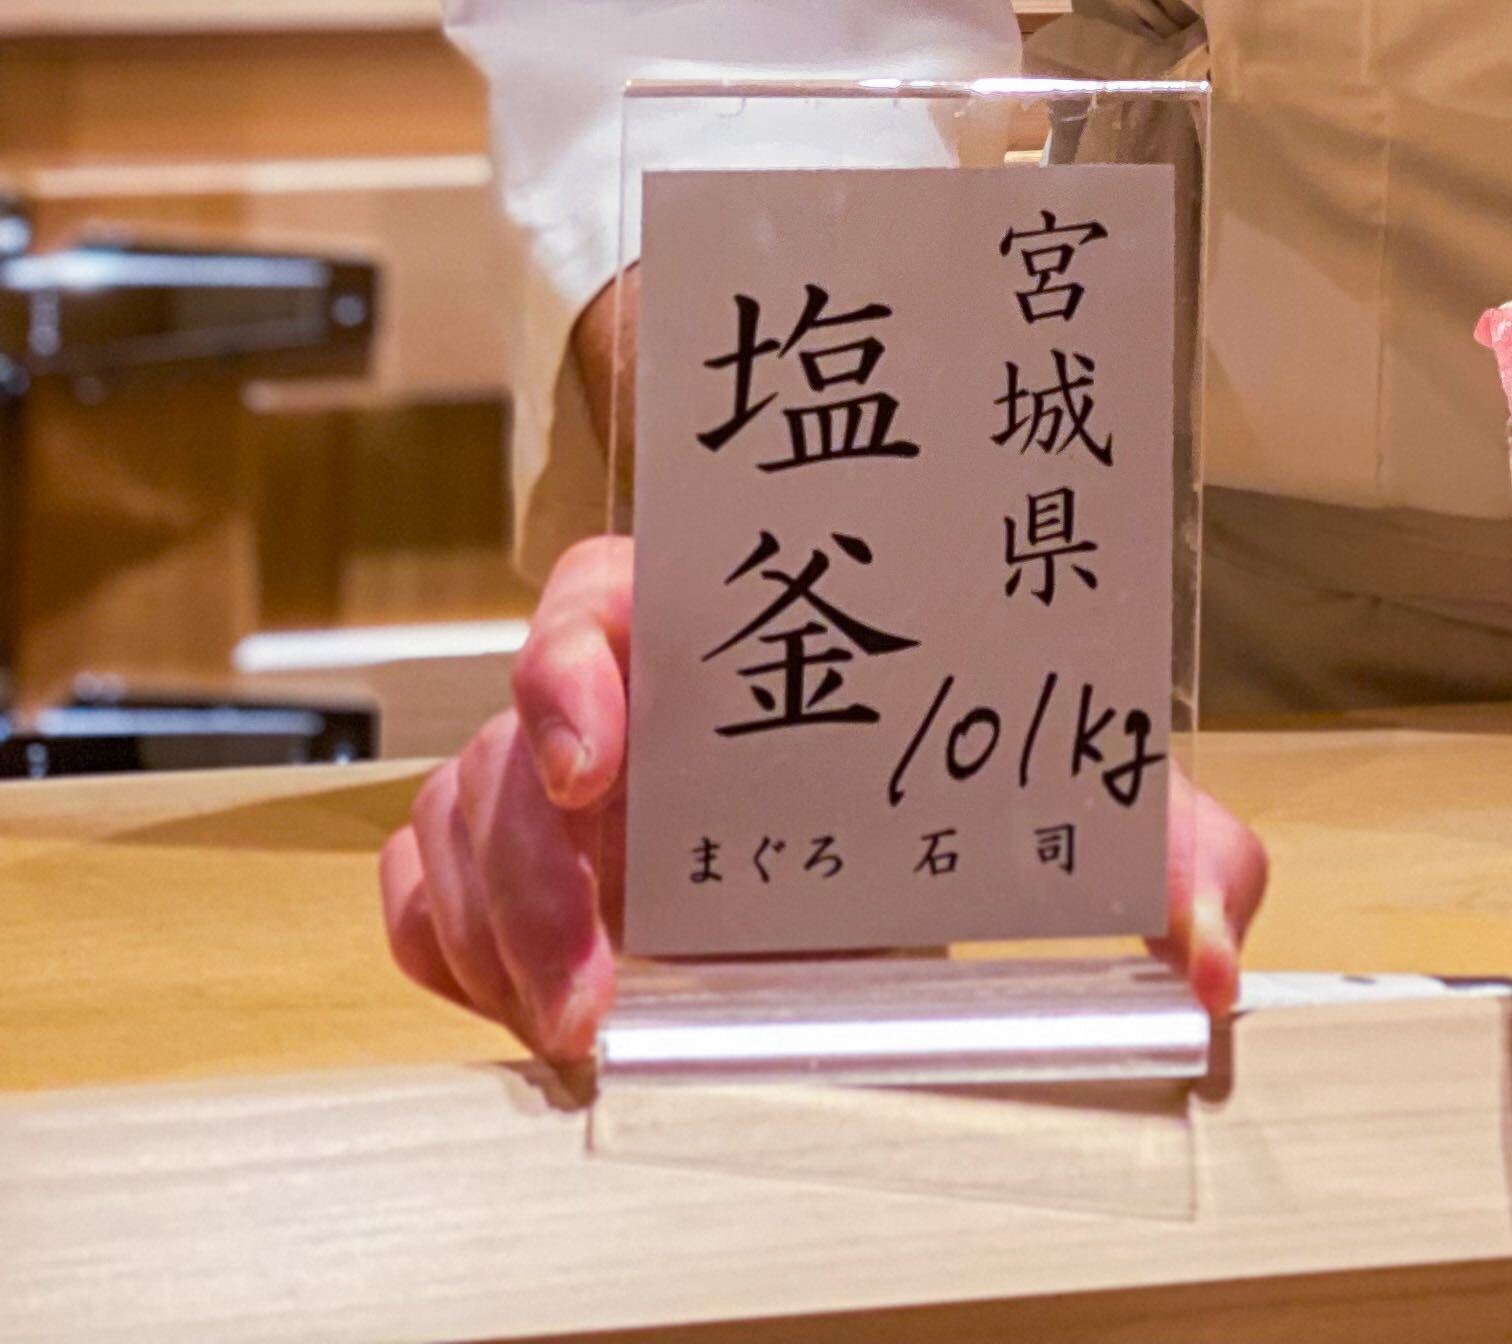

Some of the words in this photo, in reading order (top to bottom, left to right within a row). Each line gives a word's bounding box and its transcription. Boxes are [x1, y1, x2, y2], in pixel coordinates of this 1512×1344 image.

[696, 283, 923, 739] 塩釜
[991, 209, 1114, 608] 宮城県
[689, 834, 844, 885] まぐろ
[887, 671, 1167, 809] 101kg
